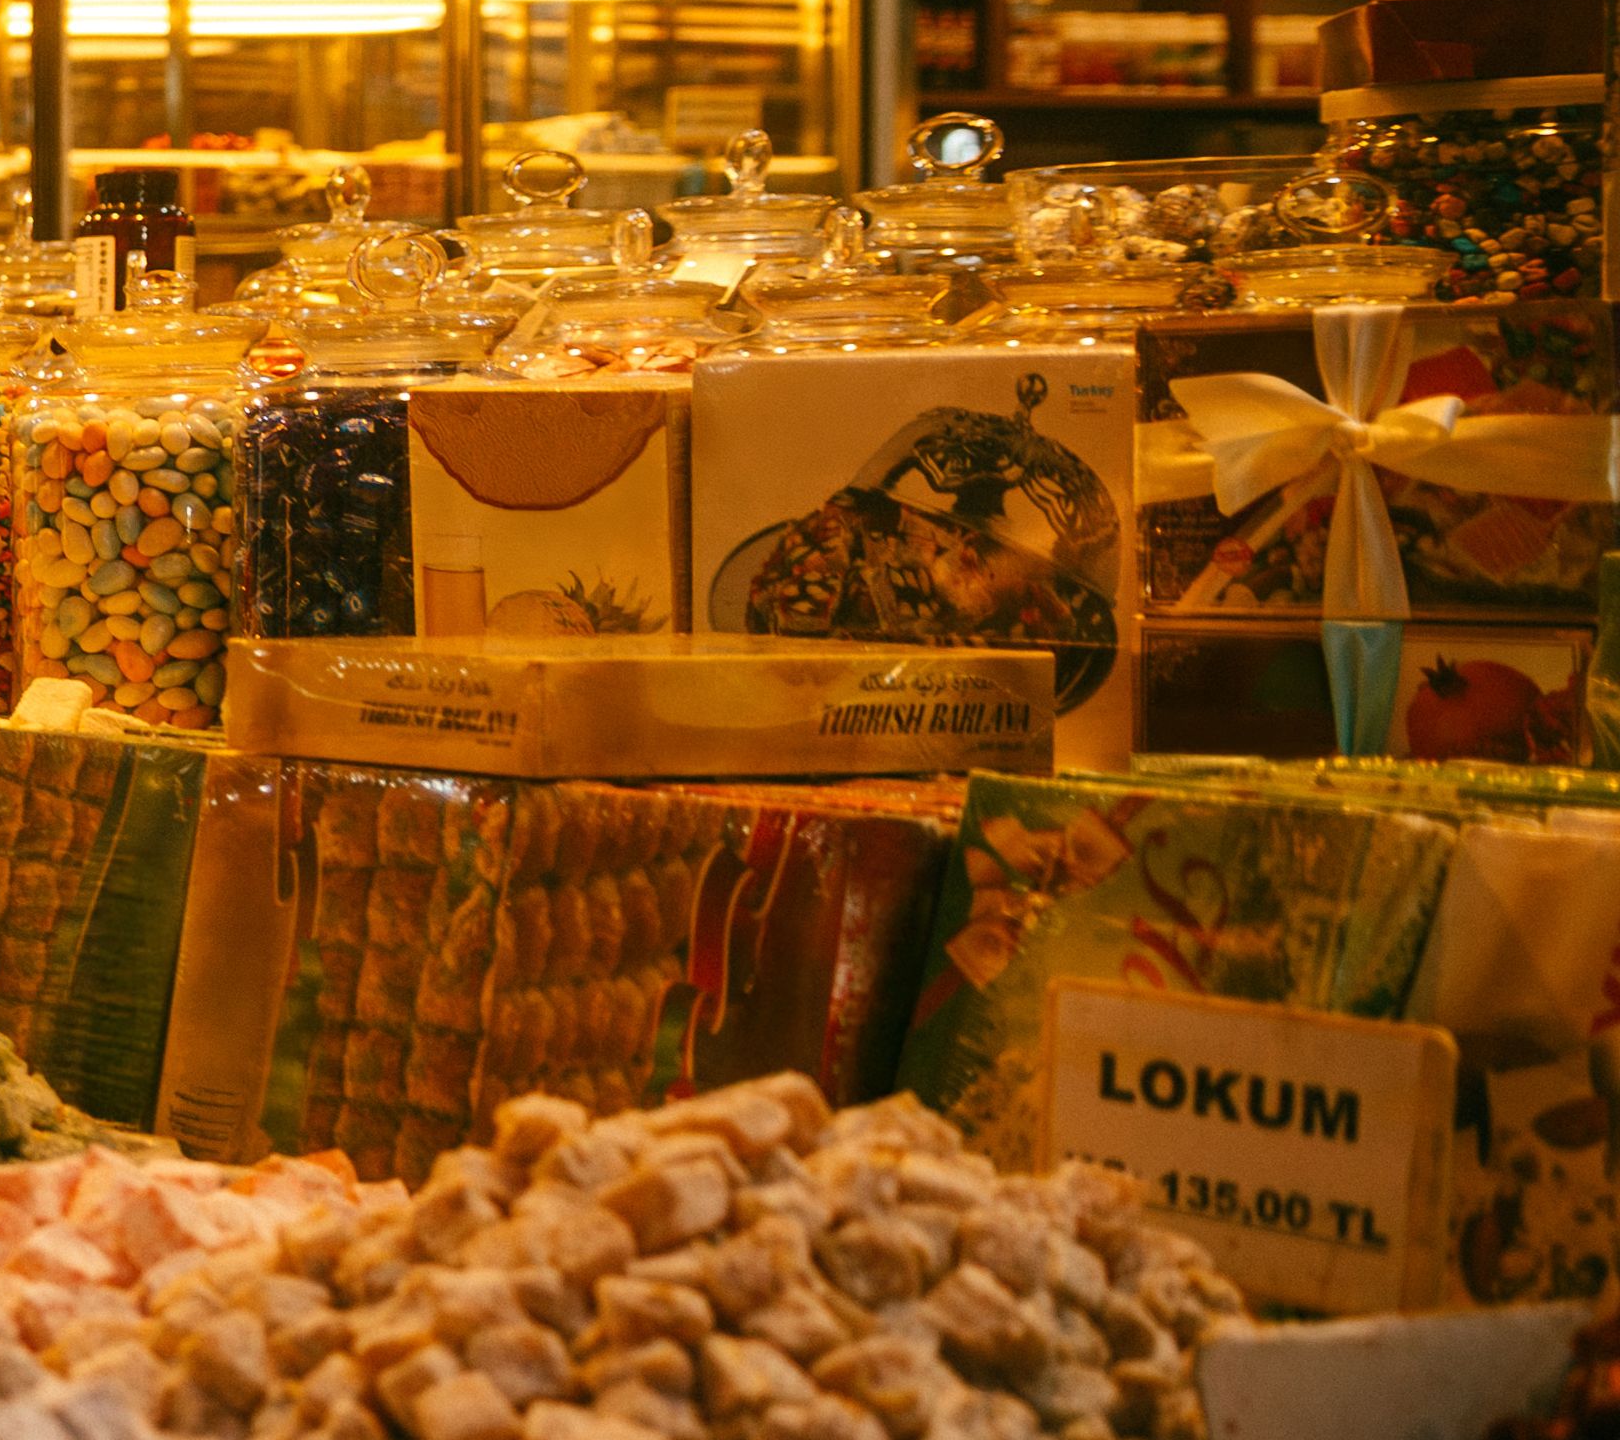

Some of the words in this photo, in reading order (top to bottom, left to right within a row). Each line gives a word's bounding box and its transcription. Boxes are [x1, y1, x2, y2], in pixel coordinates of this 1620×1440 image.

[819, 703, 926, 736] TURKISH
[929, 702, 1031, 735] BAKLAVA
[1099, 1050, 1361, 1143] LOKUM
[1160, 1169, 1313, 1231] 135,00
[1328, 1199, 1388, 1247] TL
